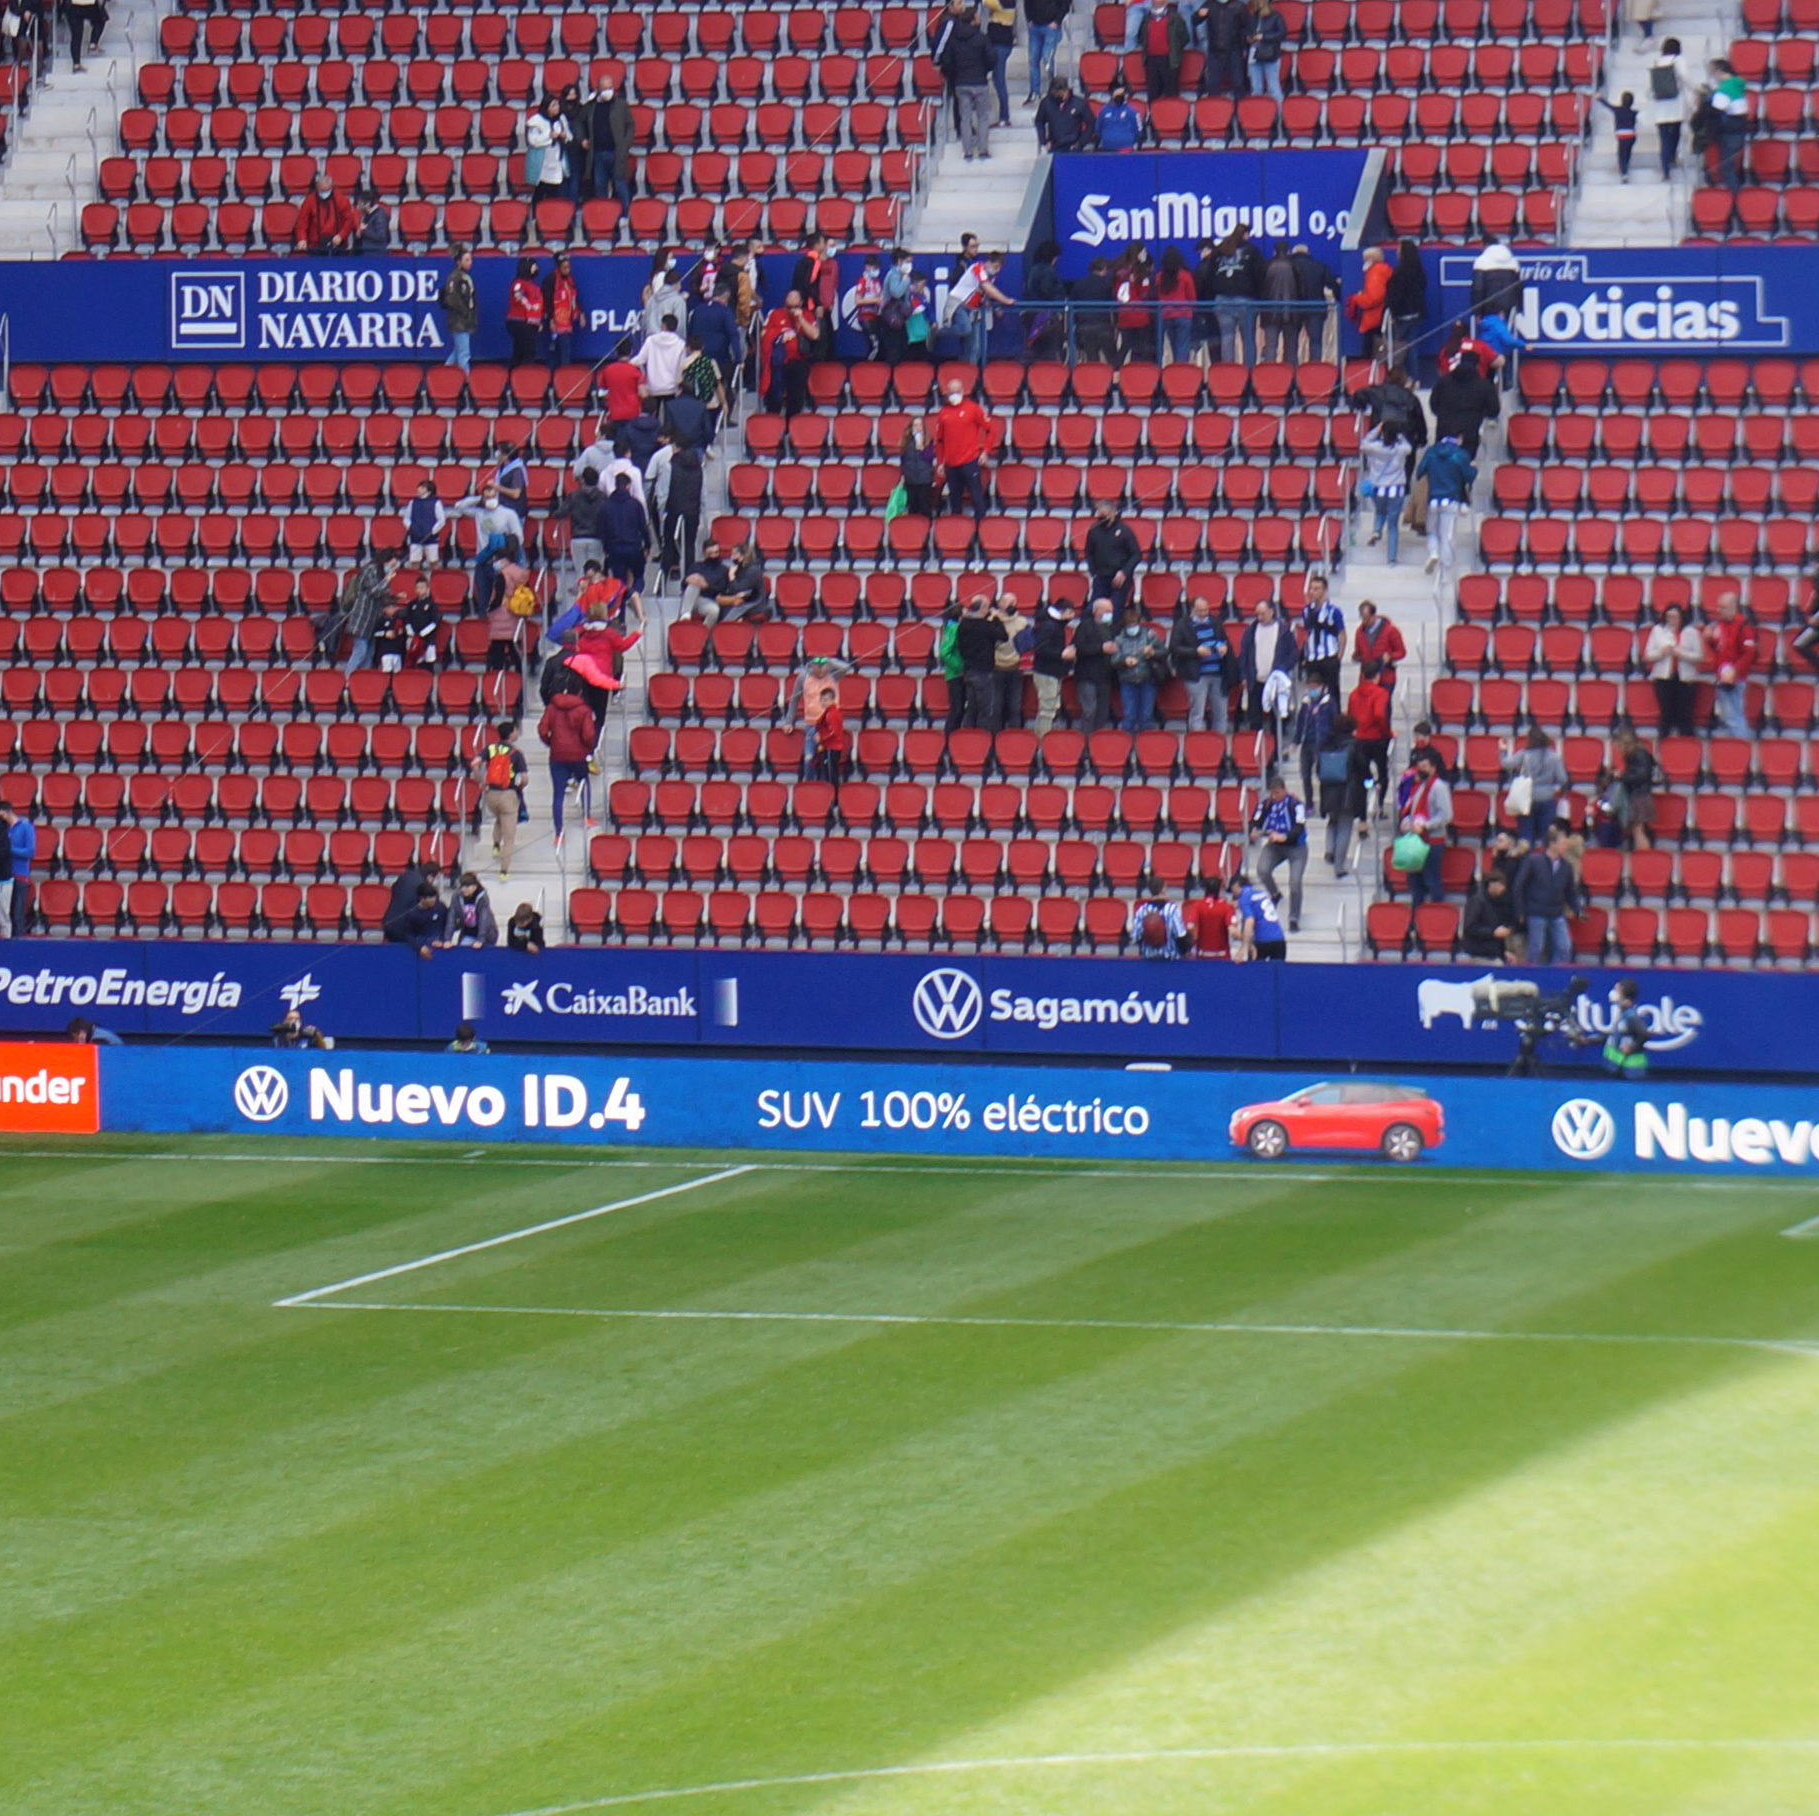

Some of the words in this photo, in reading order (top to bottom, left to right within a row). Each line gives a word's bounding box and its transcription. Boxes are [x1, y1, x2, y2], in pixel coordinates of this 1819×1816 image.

[1069, 190, 1300, 245] SanMiguel
[257, 270, 384, 303] DIARIO
[388, 270, 439, 303] DE
[1554, 257, 1580, 282] de
[180, 284, 236, 319] DN
[1514, 284, 1740, 341] Noticias
[257, 312, 445, 350] NAVARRA
[545, 982, 698, 1018] CaixaBank
[989, 987, 1190, 1031] Sagamóvil
[308, 1066, 507, 1128] Nuevo
[523, 1073, 647, 1132] ID.4
[756, 1088, 842, 1129] SUV
[859, 1090, 972, 1131] 100%
[982, 1093, 1151, 1136] eléctrico
[1633, 1101, 1819, 1166] Nuev
